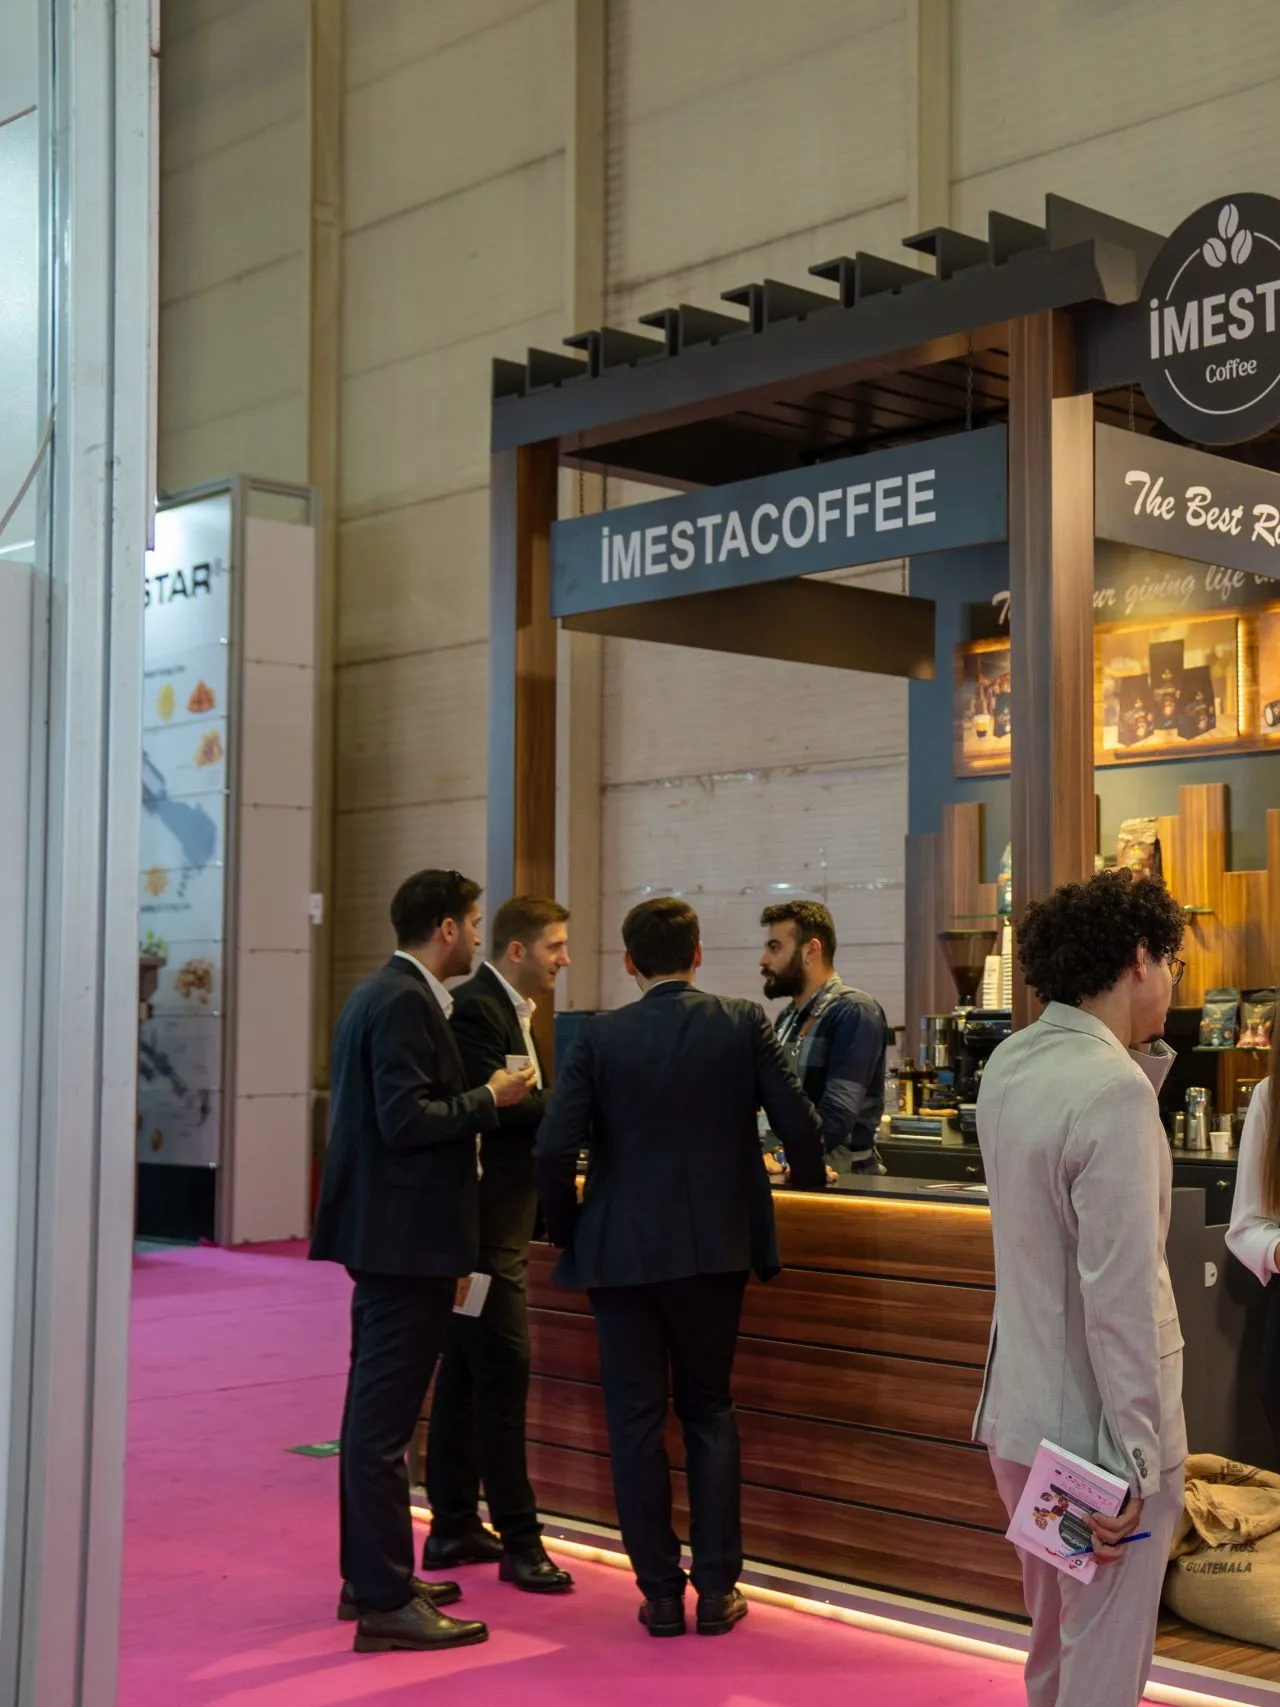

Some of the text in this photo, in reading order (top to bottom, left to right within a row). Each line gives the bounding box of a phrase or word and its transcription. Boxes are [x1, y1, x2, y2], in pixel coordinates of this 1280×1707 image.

[1205, 359, 1257, 384] Coffee
[1125, 470, 1175, 520] The
[1185, 486, 1244, 536] Best
[1125, 573, 1196, 615] giving
[1205, 565, 1245, 600] life
[1186, 1561, 1252, 1575] GUATEMALA
